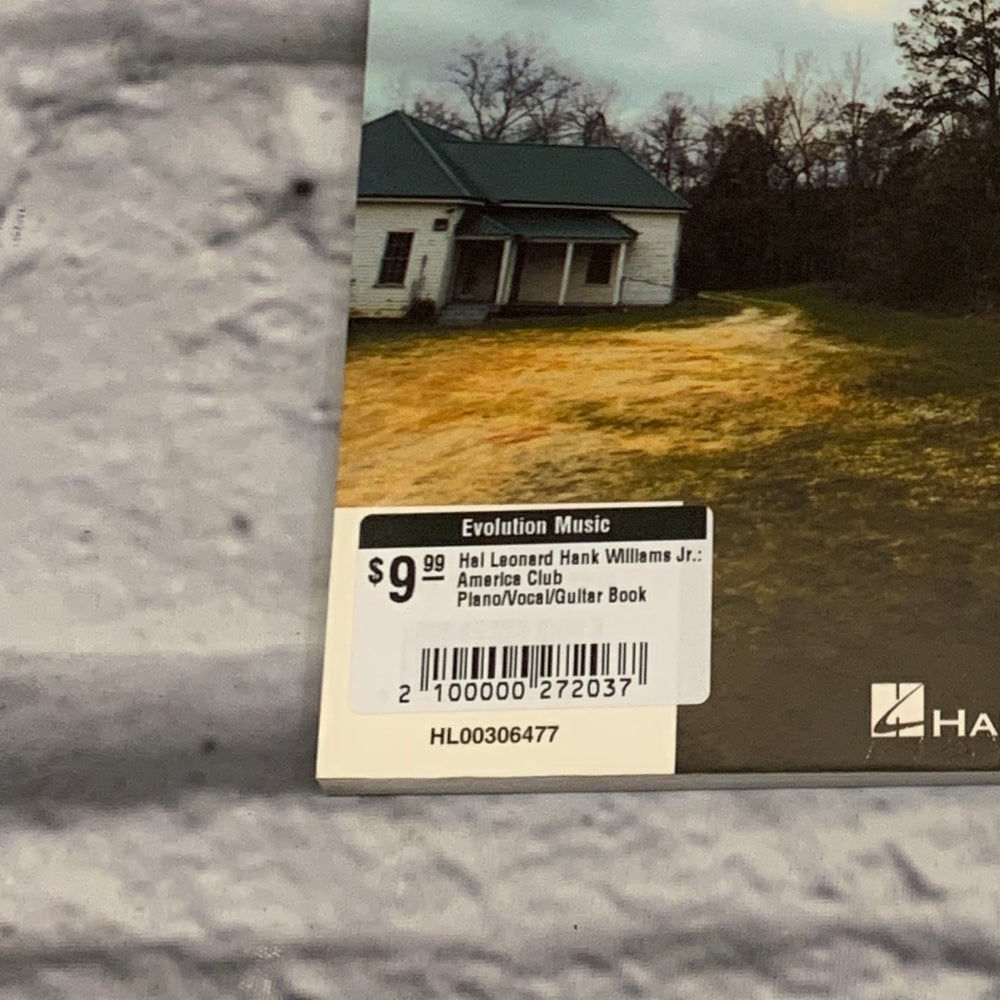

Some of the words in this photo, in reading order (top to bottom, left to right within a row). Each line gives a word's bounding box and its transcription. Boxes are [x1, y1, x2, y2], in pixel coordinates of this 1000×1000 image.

[462, 517, 547, 536] Evolution
[554, 515, 610, 534] Music
[458, 553, 484, 568] Hal
[490, 552, 553, 567] Leonard
[559, 549, 599, 565] Hank
[675, 547, 702, 562] Jr.:
[457, 572, 521, 588] America
[526, 571, 563, 586] Club
[457, 589, 603, 607] Piano/Vocal/Guitar
[608, 587, 646, 603] Book
[434, 682, 525, 701] 100000
[540, 679, 631, 699] 272037
[430, 726, 559, 745] HL00306477
